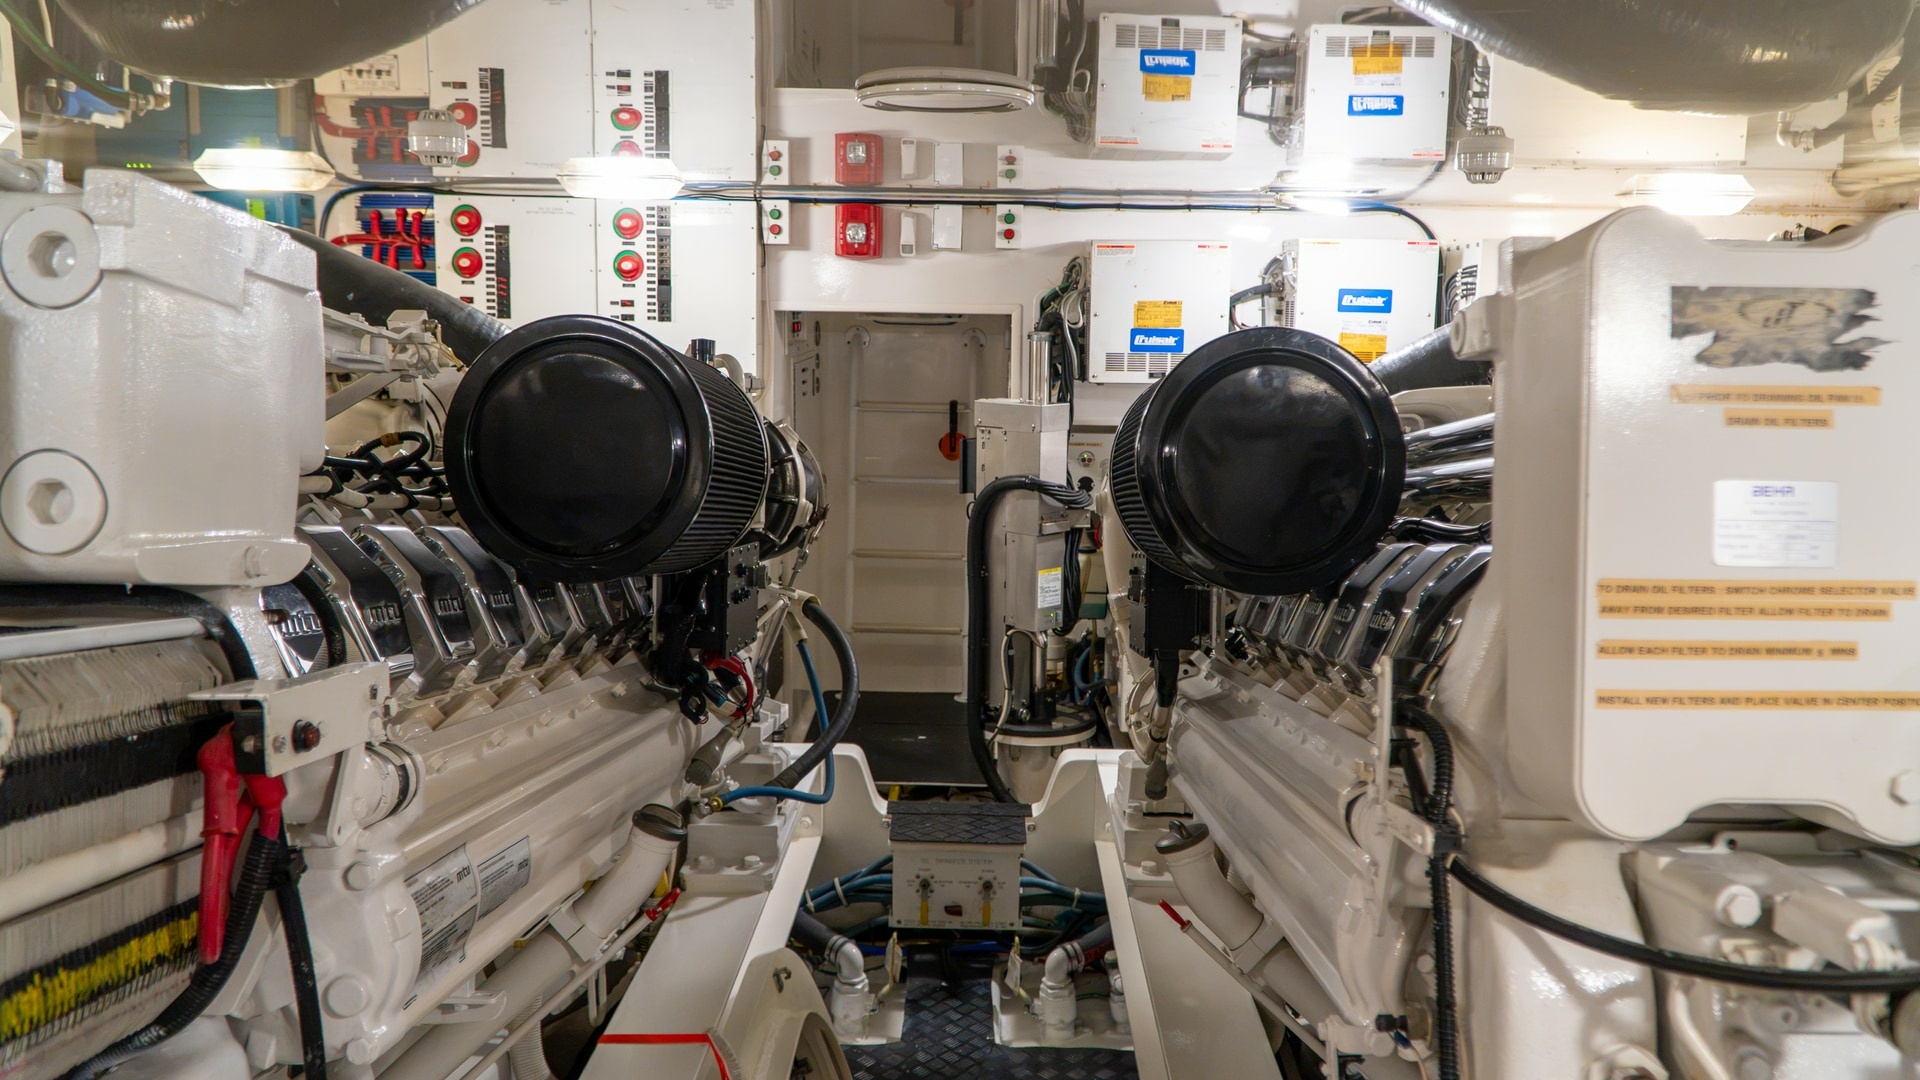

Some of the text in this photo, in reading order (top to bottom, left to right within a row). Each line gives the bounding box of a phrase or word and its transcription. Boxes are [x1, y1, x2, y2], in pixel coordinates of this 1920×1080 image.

[1342, 295, 1388, 306] Cruisair
[1134, 335, 1180, 345] Cruisair
[1728, 417, 1829, 427] DRAIN OIL FILTERS
[1599, 585, 1613, 593] TO
[1616, 585, 1649, 594] DRAIN
[1651, 585, 1668, 594] OIL
[1671, 586, 1715, 594] FILTERS
[1726, 586, 1765, 595] SWITCH
[1601, 606, 1630, 614] AWAY
[1632, 606, 1665, 614] FROM
[1667, 607, 1714, 615] DESIRED
[1718, 607, 1754, 615] FILTER
[1759, 608, 1794, 616] ALLOW
[1797, 608, 1833, 616] FILTER
[1600, 646, 1635, 655] ALLOW
[1639, 647, 1668, 655] EACH
[1671, 647, 1707, 655] FILTER
[1712, 647, 1726, 655] TO
[1728, 647, 1760, 655] DRAIN
[1598, 696, 1642, 705] INSTALL
[1645, 697, 1669, 705] NEW
[1671, 697, 1715, 705] FILTERS
[1719, 697, 1742, 705] AND
[1745, 697, 1780, 706] PLACE
[456, 865, 471, 883] mtu
